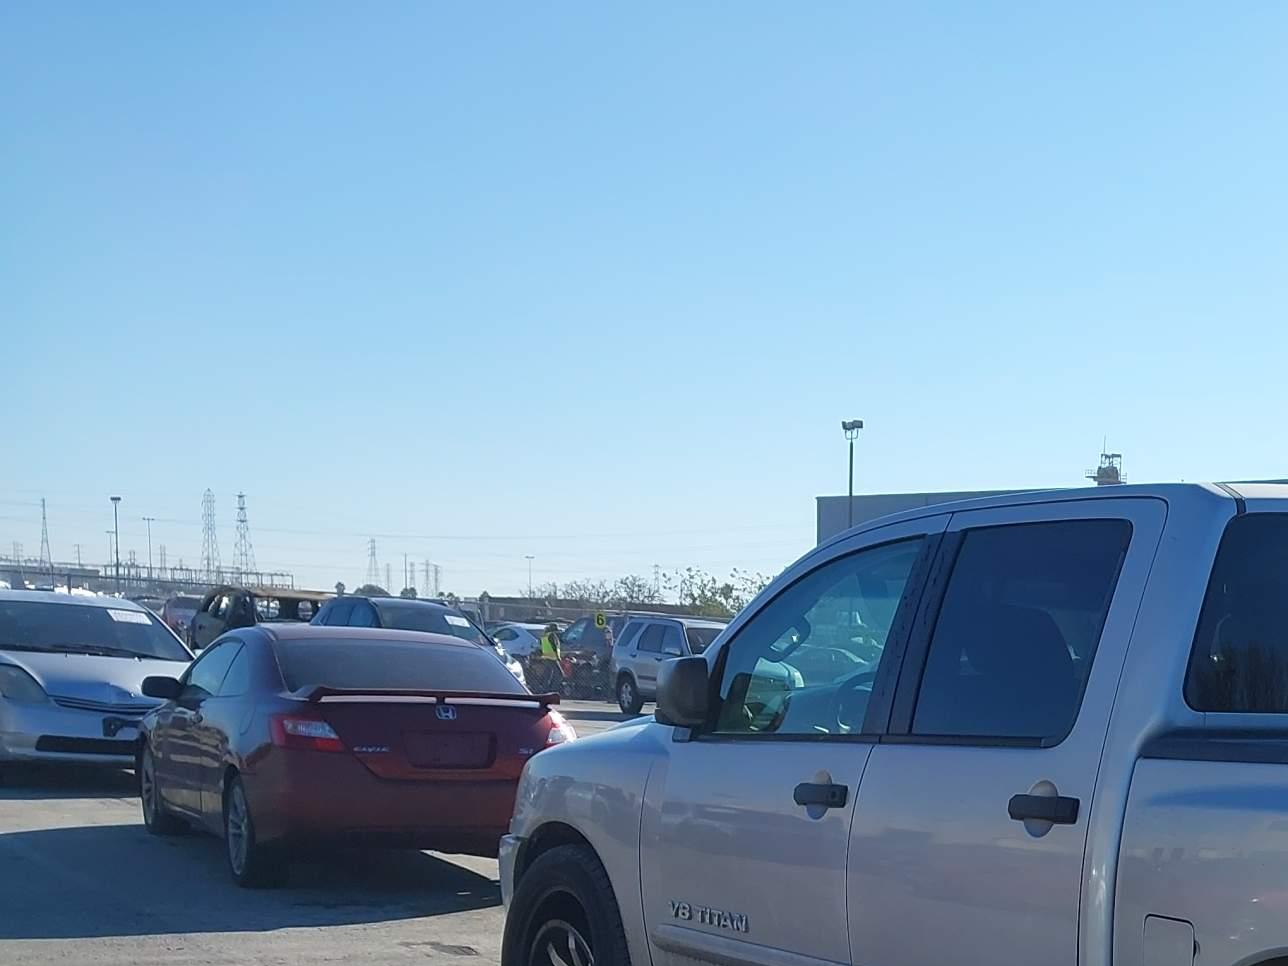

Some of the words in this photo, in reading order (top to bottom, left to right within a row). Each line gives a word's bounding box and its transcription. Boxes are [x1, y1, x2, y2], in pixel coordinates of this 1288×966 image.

[596, 613, 605, 626] 6
[668, 899, 692, 920] V8
[694, 904, 749, 933] TITAN
